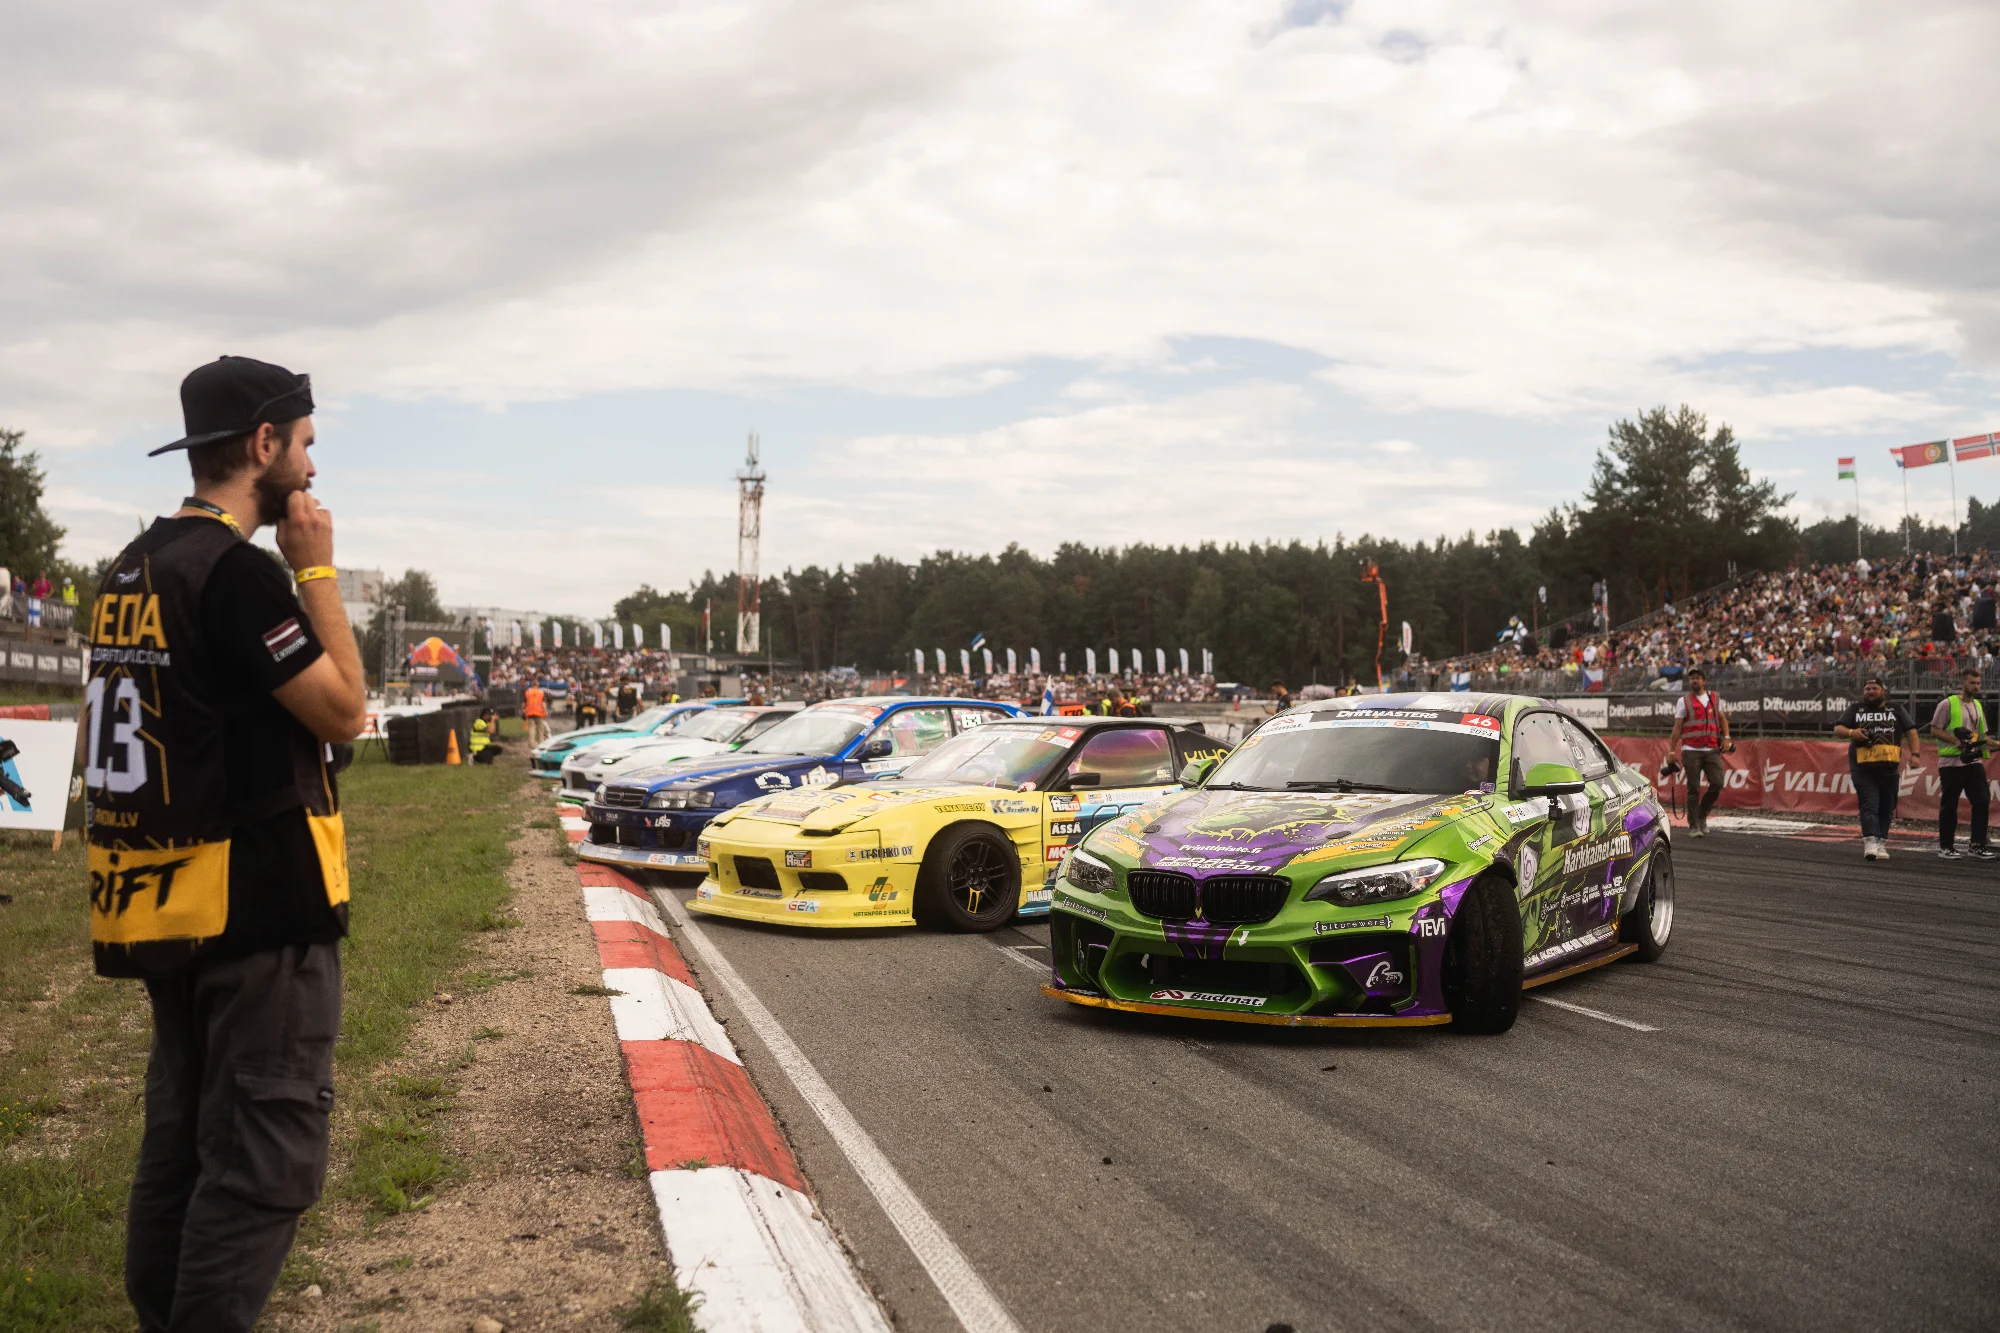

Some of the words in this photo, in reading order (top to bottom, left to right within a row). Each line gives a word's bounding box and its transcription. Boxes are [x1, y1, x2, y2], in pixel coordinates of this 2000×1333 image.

[1374, 719, 1389, 727] by
[1467, 717, 1492, 727] 46
[1855, 712, 1897, 723] MEDIA
[86, 676, 148, 793] 13
[788, 901, 818, 913] G2A
